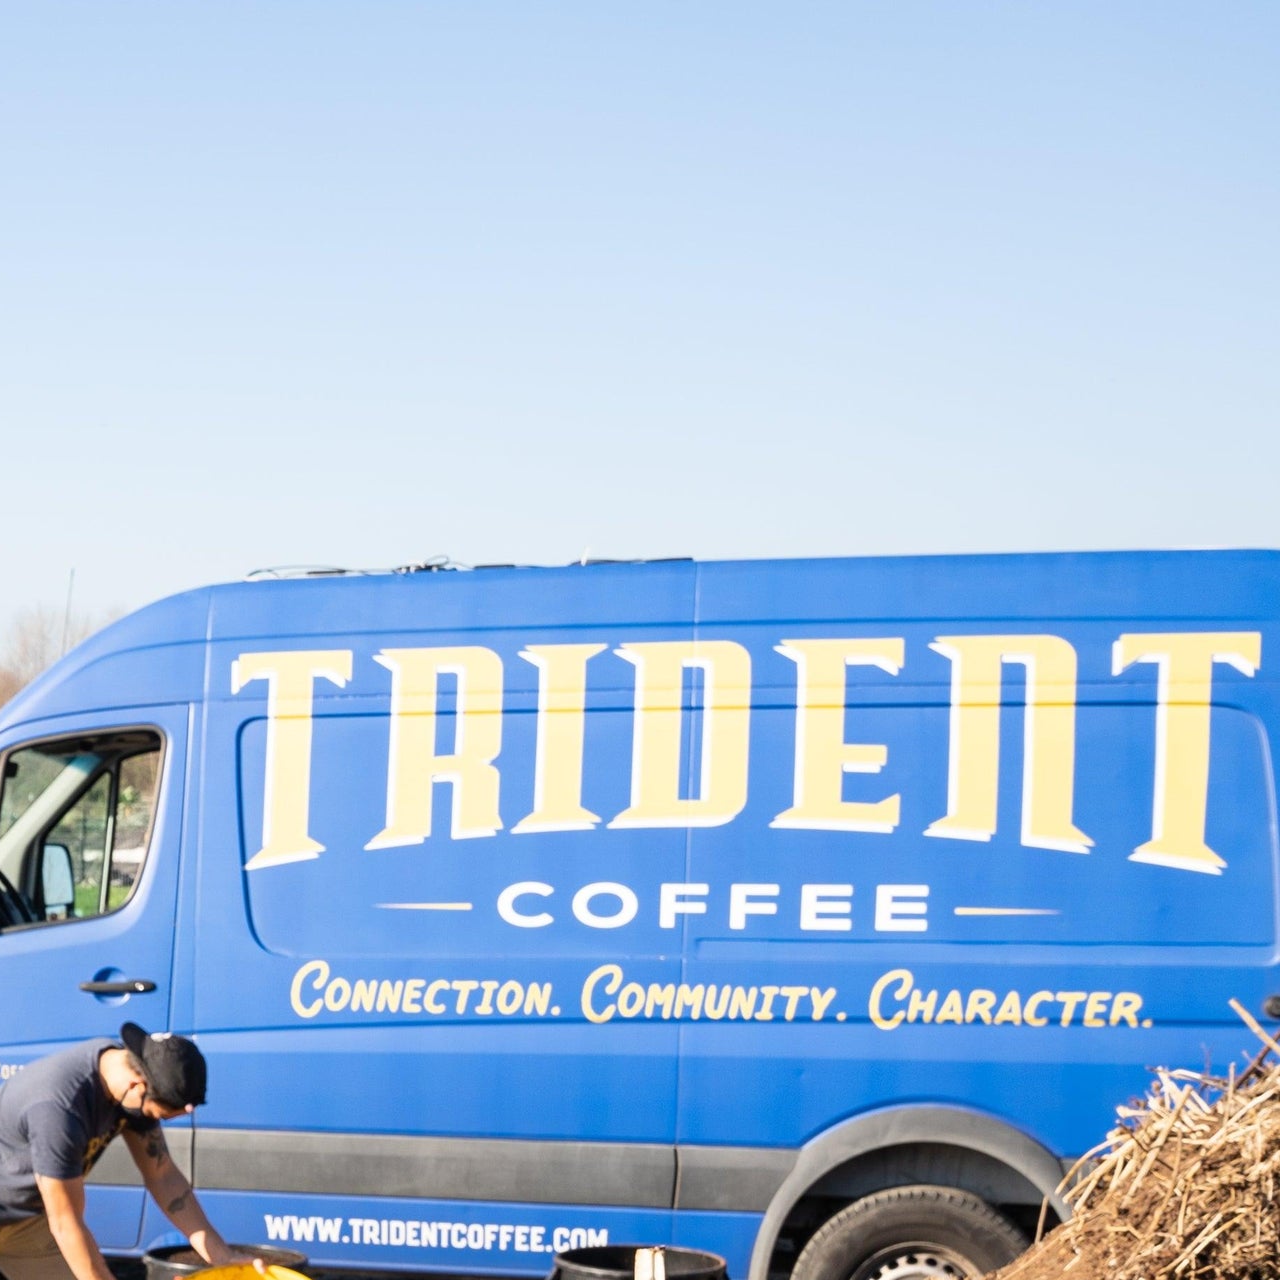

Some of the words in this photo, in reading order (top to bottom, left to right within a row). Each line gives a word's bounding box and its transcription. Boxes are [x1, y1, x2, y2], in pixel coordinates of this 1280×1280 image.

[231, 631, 1262, 875] TRIDENT
[496, 881, 930, 932] COFFEE
[264, 1215, 608, 1252] WWW.TRIDENTCOFFEE.COM
